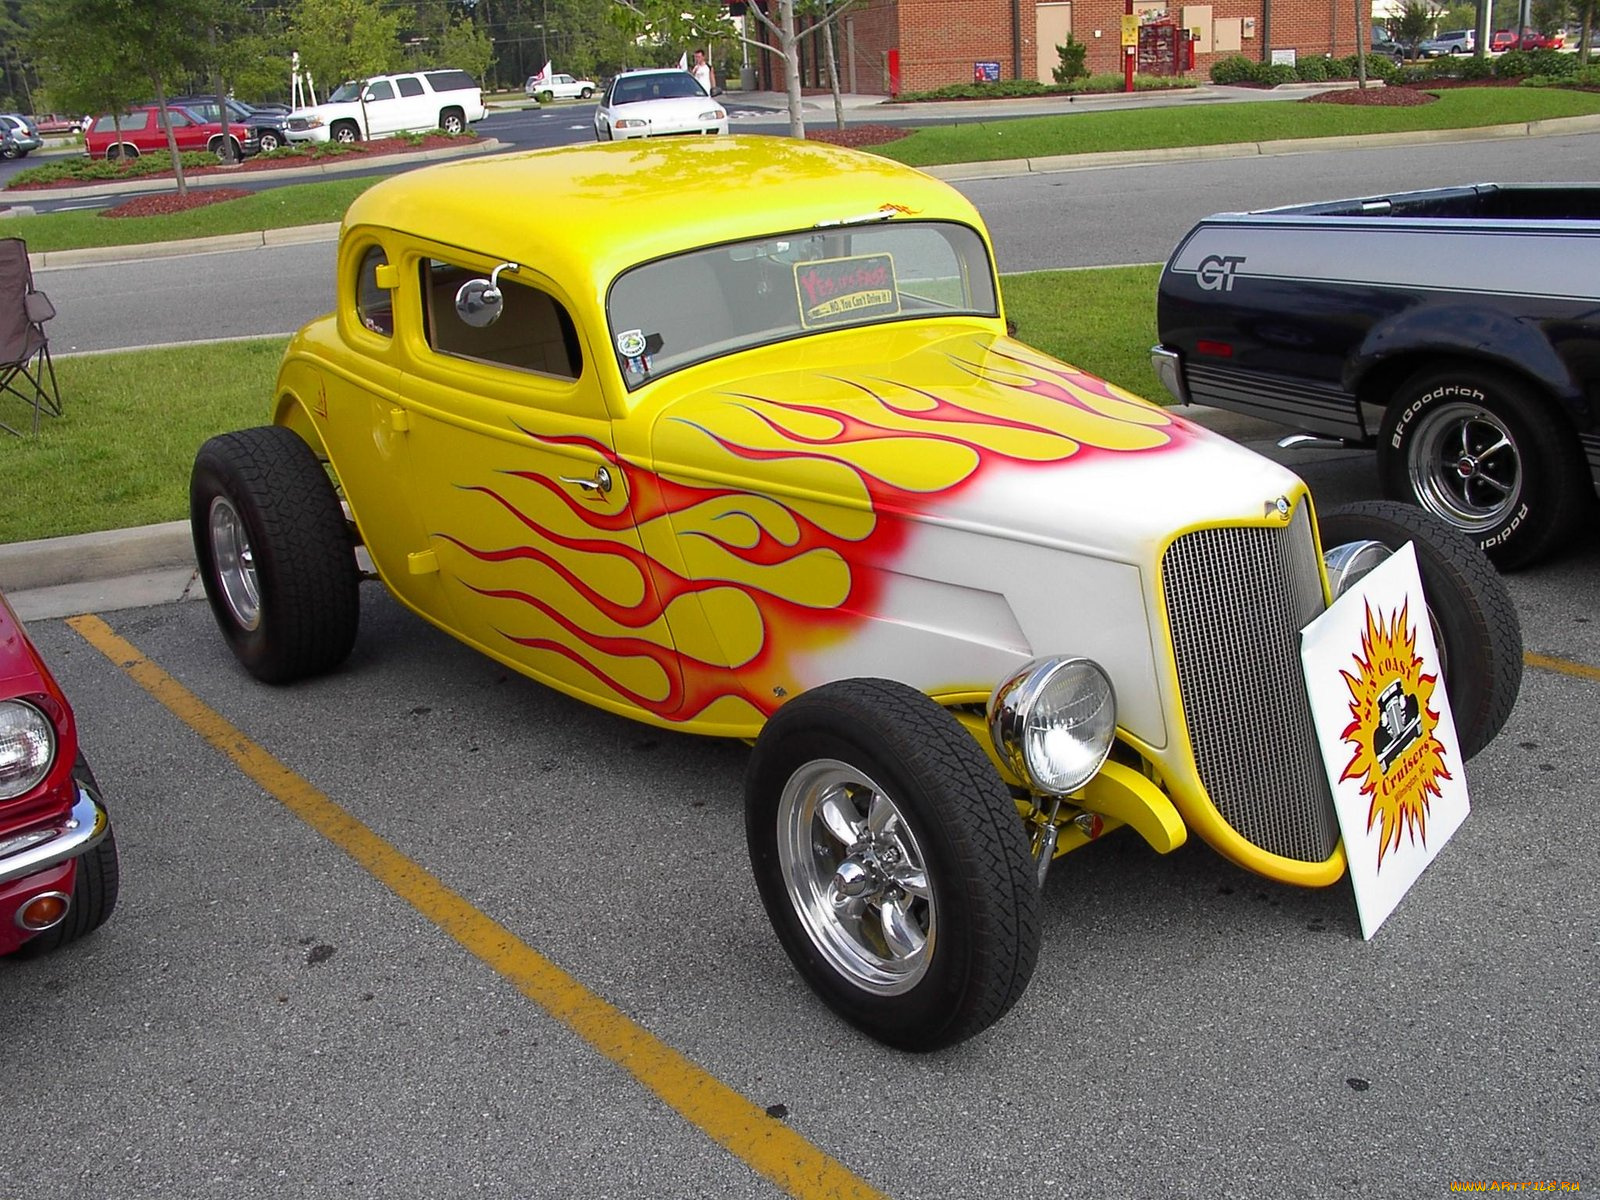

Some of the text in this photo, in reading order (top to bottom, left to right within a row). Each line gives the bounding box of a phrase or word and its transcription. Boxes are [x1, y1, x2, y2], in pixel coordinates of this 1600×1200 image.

[1196, 253, 1247, 291] GT
[1391, 385, 1485, 449] BFGoodrich
[1480, 503, 1529, 550] Radial
[1378, 657, 1411, 682] COAST
[1382, 740, 1430, 796] Cruisers
